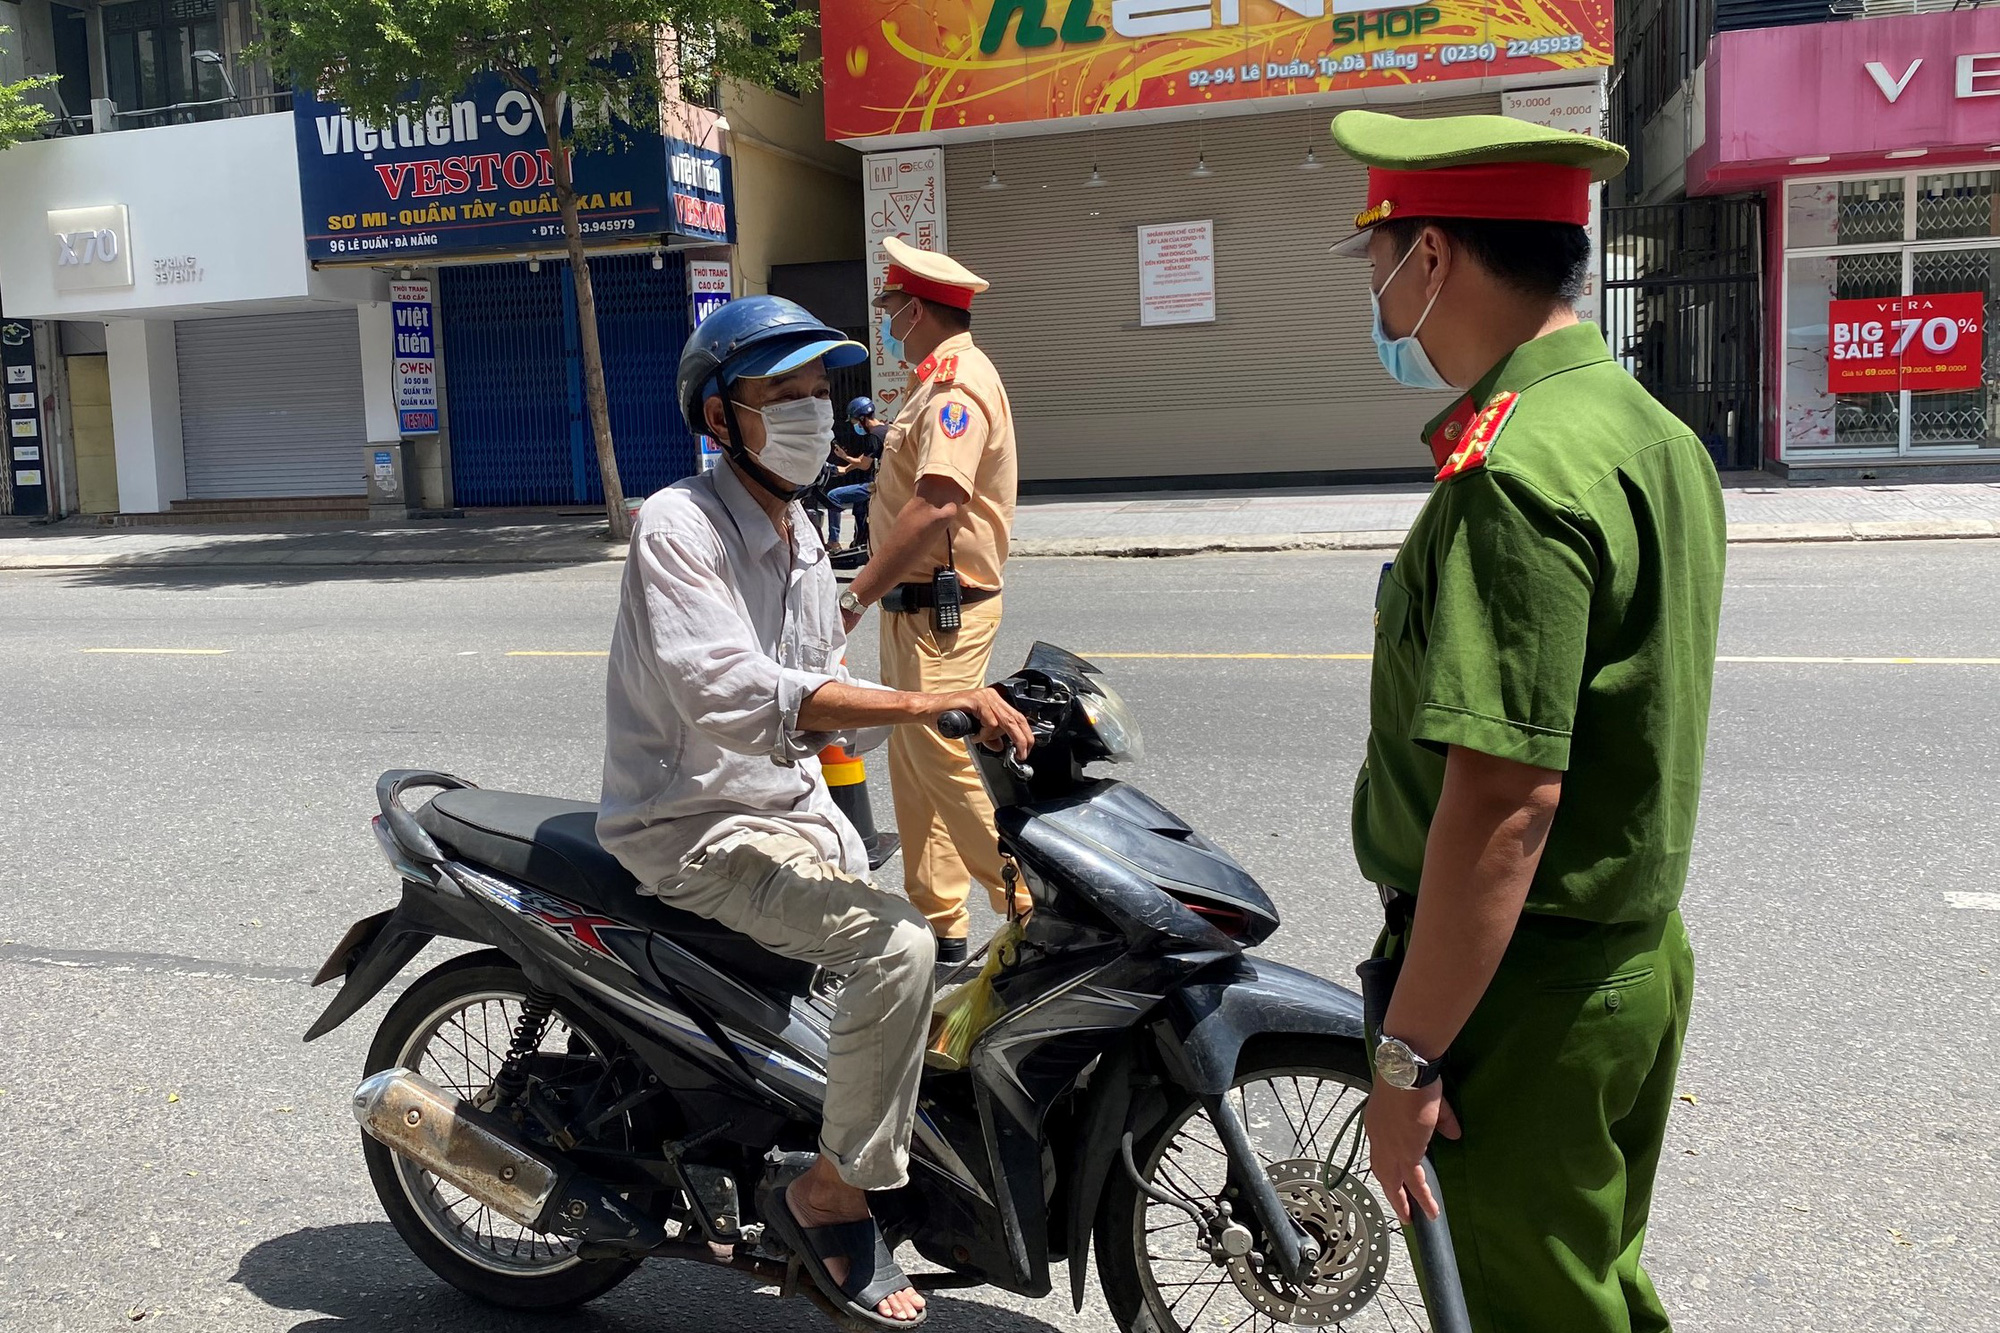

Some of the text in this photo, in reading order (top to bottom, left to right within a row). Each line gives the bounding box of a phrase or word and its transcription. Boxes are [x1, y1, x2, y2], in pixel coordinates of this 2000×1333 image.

[1333, 7, 1440, 44] SHOP
[1189, 67, 1235, 87] 92-94
[1241, 63, 1261, 82] Lê
[1372, 49, 1418, 71] Nẵng
[1440, 42, 1496, 66] (0236)
[1506, 34, 1583, 58] 2245933
[1510, 97, 1551, 109] 39.000đ
[1550, 105, 1592, 116] 49.000đ
[375, 148, 574, 200] VESTON
[875, 166, 892, 182] GAP
[895, 193, 918, 202] GUESS
[924, 176, 935, 215] Clarks
[328, 212, 357, 231] SƠ
[361, 211, 388, 228] MI
[399, 201, 456, 225] QUẦN
[460, 199, 498, 219] TÂY
[609, 190, 632, 207] KI
[673, 192, 726, 233] VESTON
[871, 199, 896, 228] ck
[55, 228, 118, 266] X70
[330, 240, 346, 253] 96
[348, 238, 360, 250] LÊ
[395, 235, 408, 248] ĐÀ
[410, 232, 438, 247] NẴNG
[153, 255, 196, 269] SPRING
[709, 269, 728, 277] TRANG
[698, 279, 725, 290] CAO CẤP
[1877, 301, 1933, 312] VERA
[396, 306, 429, 330] việt
[398, 332, 430, 353] tiến
[1833, 321, 1884, 344] BIG
[1890, 316, 1977, 357] 70%
[876, 327, 884, 366] DKNY
[1833, 342, 1884, 360] SALE
[400, 362, 432, 374] OWEN
[403, 412, 435, 429] VESTON
